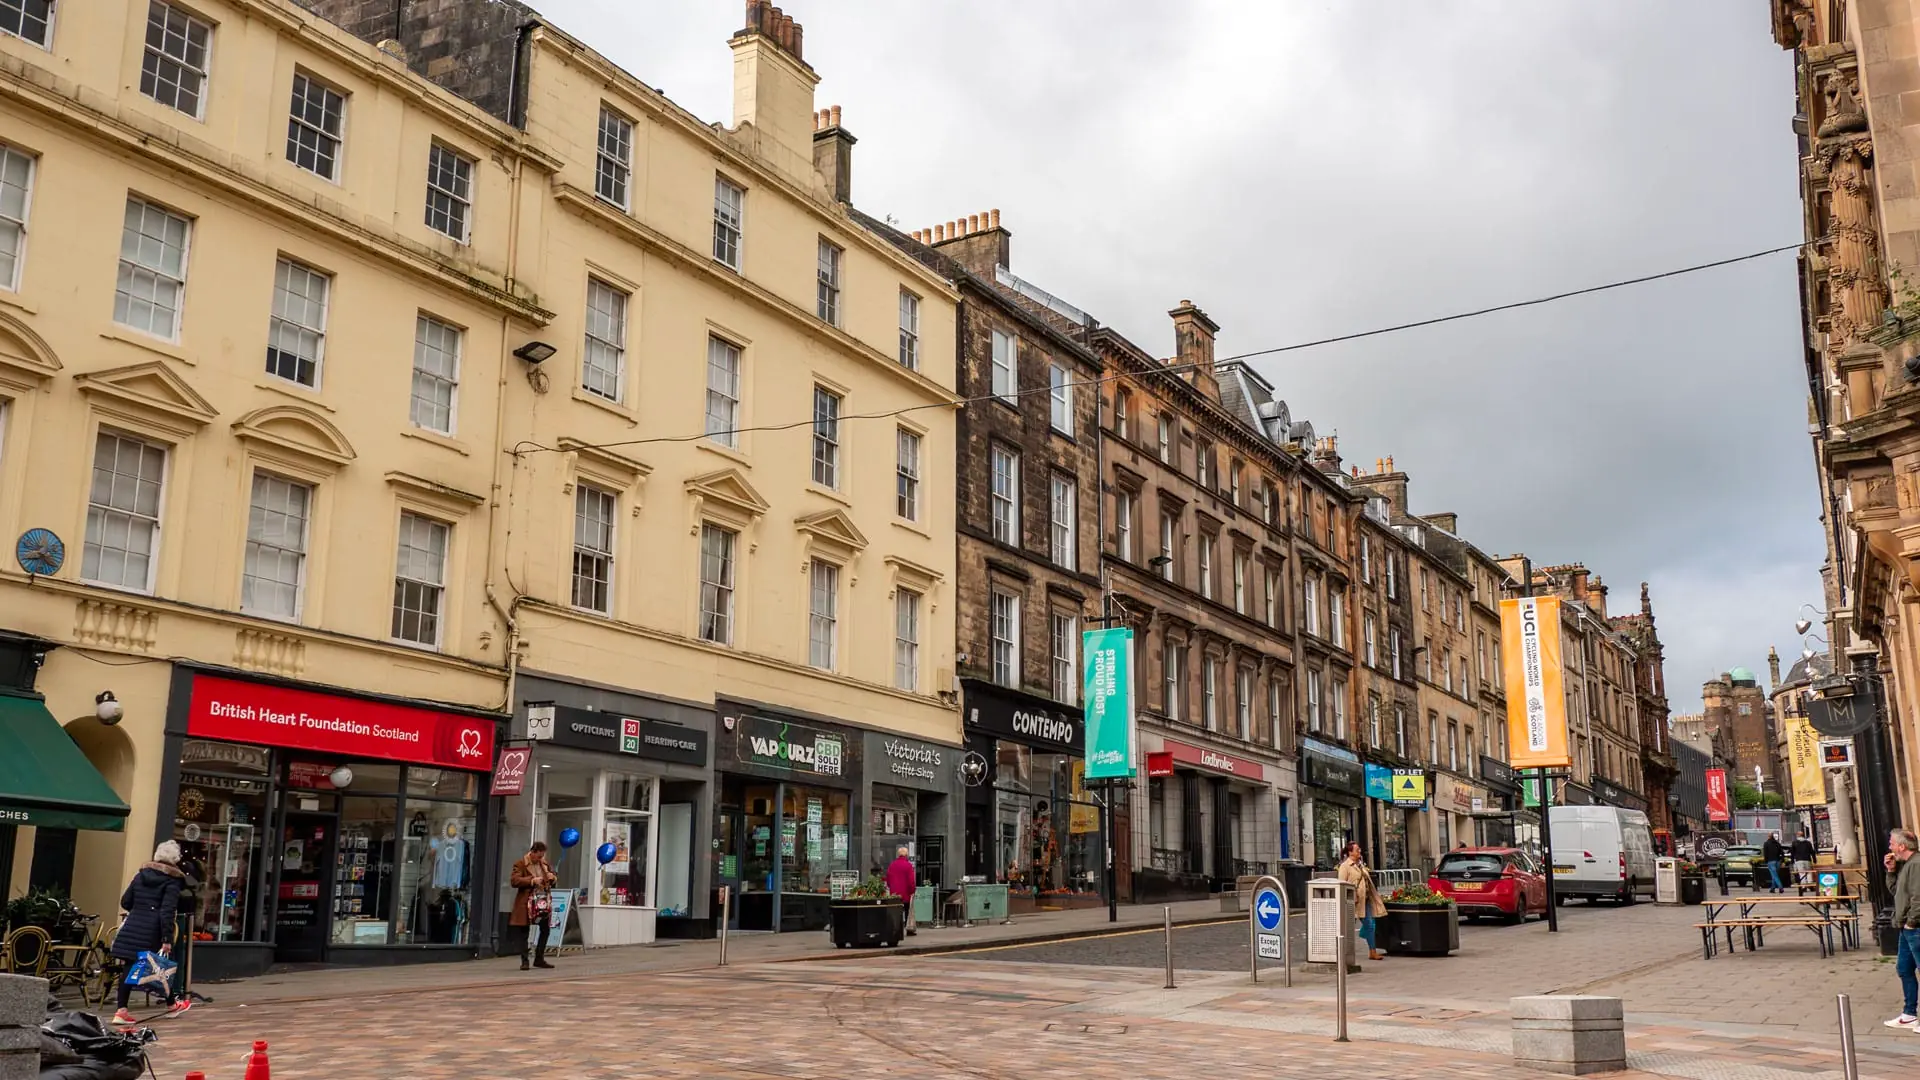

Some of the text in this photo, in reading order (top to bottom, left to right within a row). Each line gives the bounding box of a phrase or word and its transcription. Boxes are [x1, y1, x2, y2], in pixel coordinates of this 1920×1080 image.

[1523, 611, 1535, 636] UCI
[1530, 638, 1538, 663] CYCLING
[1106, 649, 1116, 696] STIRLING
[1525, 638, 1534, 687] CHAMPIONSHIPS
[1095, 650, 1105, 716] PROUD HOST
[210, 701, 419, 742] British Heart Foundation Scotland
[571, 722, 615, 738] OPTICIANS
[627, 723, 636, 734] 20
[1012, 710, 1073, 744] CONTEMPO
[1530, 714, 1538, 746] SCOTLAND
[626, 739, 636, 750] 20
[645, 735, 697, 751] HEARING CARE
[750, 736, 815, 764] VAPOURZ
[816, 742, 840, 757] CBD
[884, 740, 941, 766] Victoria's
[818, 755, 839, 766] SOLD
[818, 765, 839, 775] HERE
[1200, 750, 1234, 771] Ladbrokes
[892, 762, 935, 783] Coffee Shop
[1260, 937, 1278, 946] Except
[1261, 946, 1278, 954] cycles
